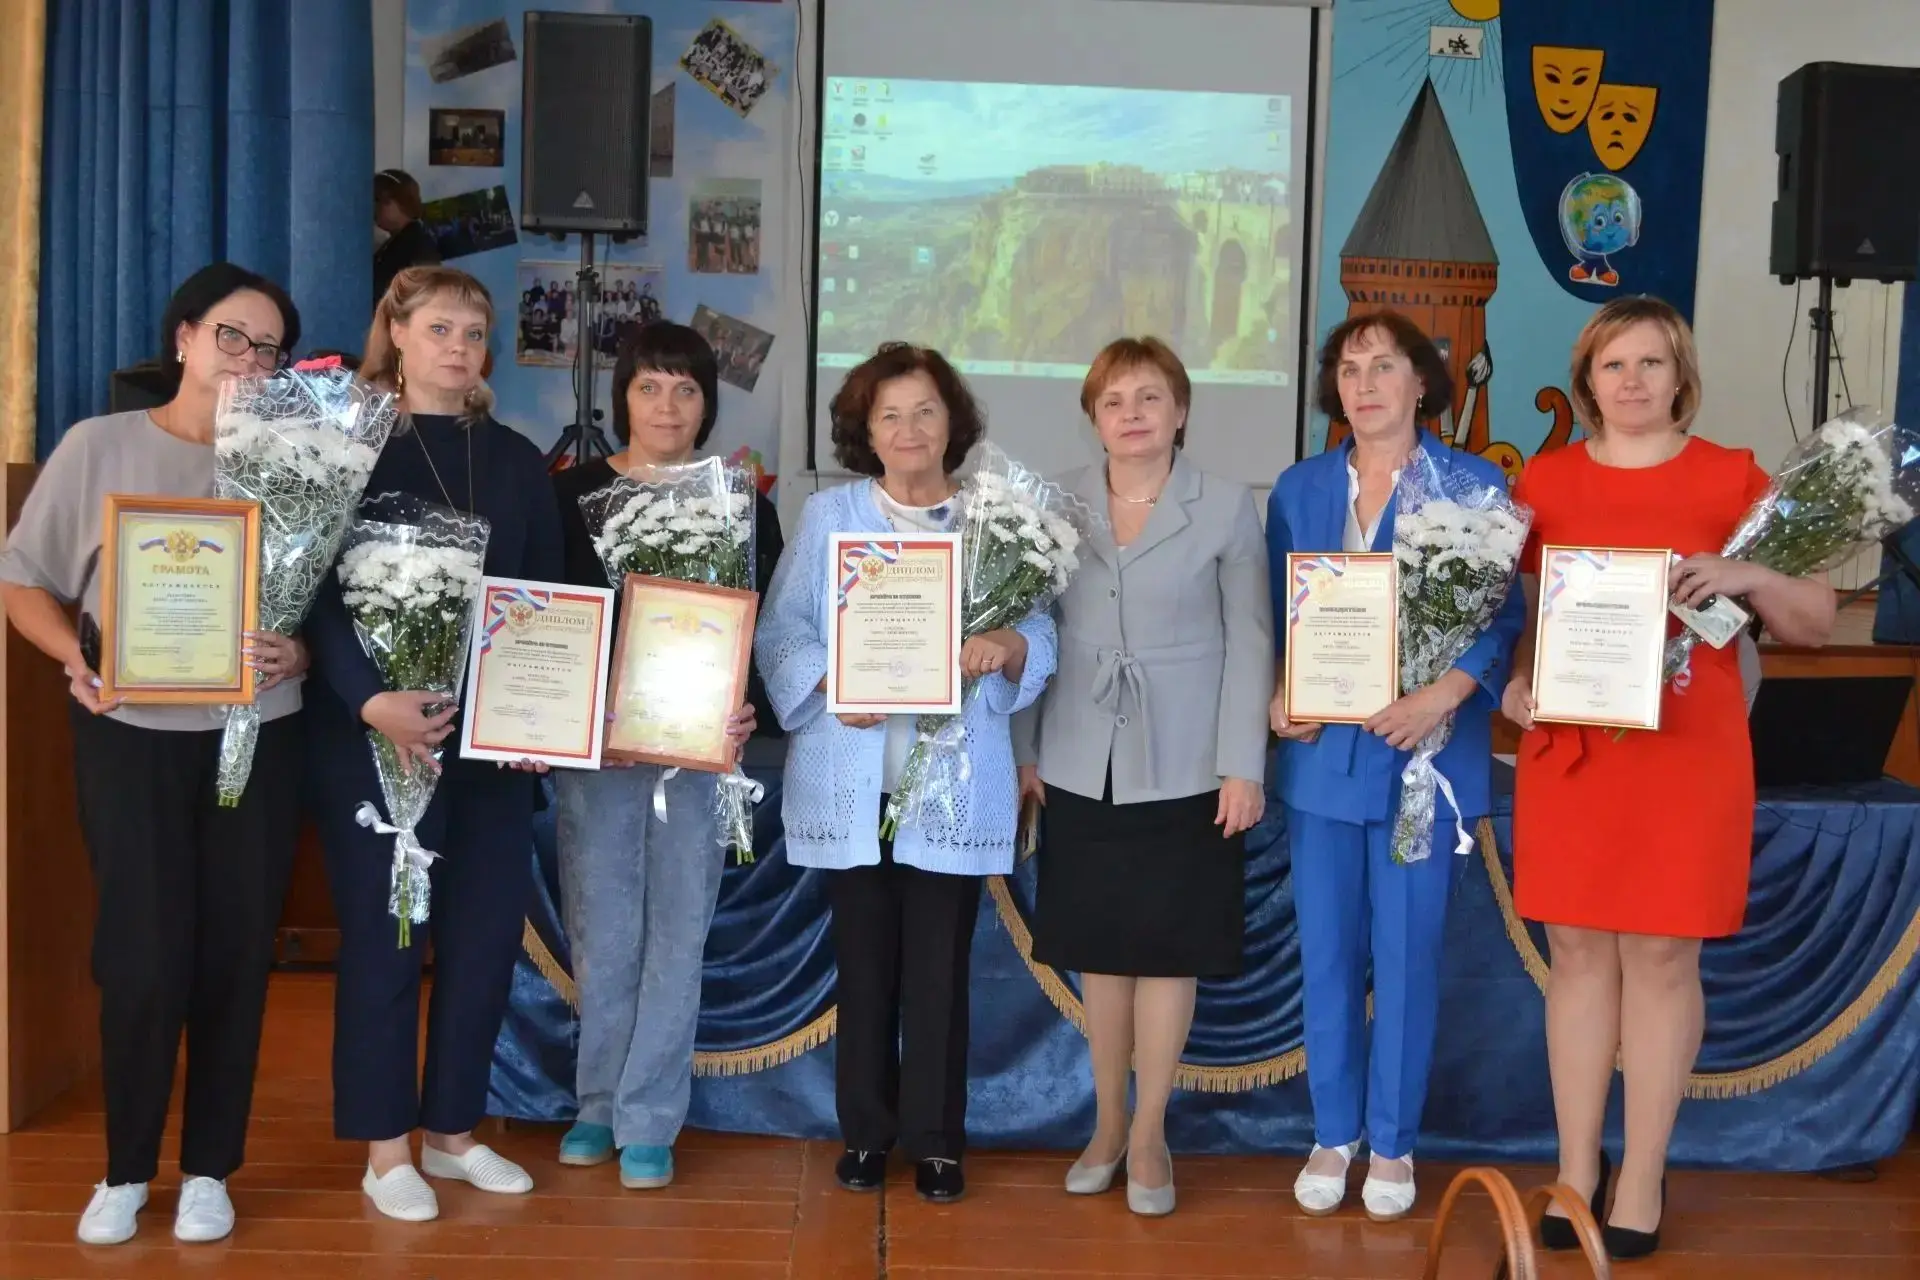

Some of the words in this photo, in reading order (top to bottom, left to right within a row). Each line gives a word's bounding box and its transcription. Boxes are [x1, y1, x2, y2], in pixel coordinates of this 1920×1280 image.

[152, 564, 210, 575] ГРАМОТА
[889, 566, 935, 576] ДИПЛОМ
[536, 615, 585, 625] ДИПЛОМ
